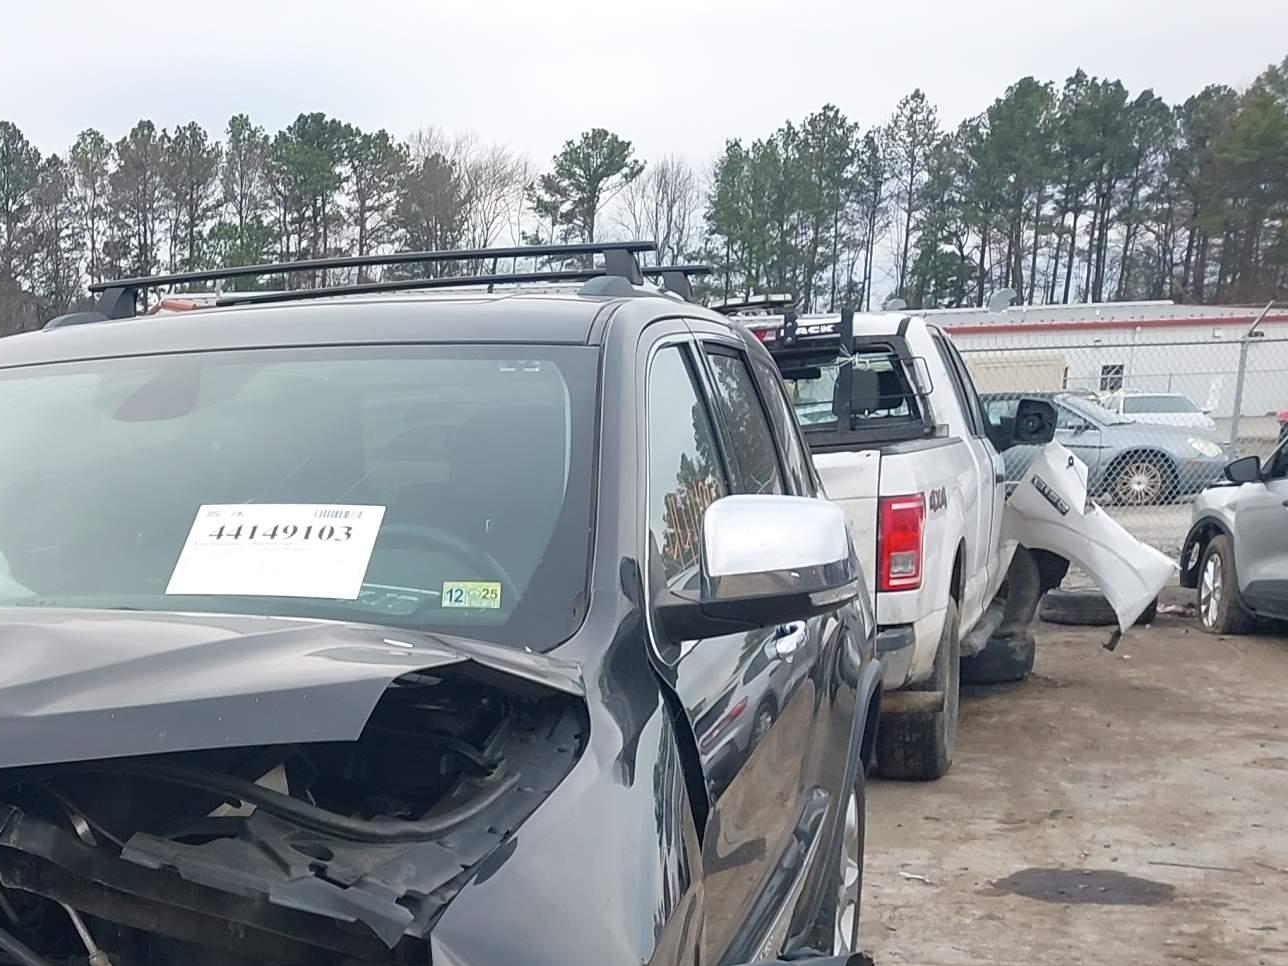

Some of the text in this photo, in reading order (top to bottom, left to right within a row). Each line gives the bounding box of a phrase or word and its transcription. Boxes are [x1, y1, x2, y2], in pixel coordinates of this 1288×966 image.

[208, 524, 353, 541] 44149103
[446, 588, 498, 603] 12 25
